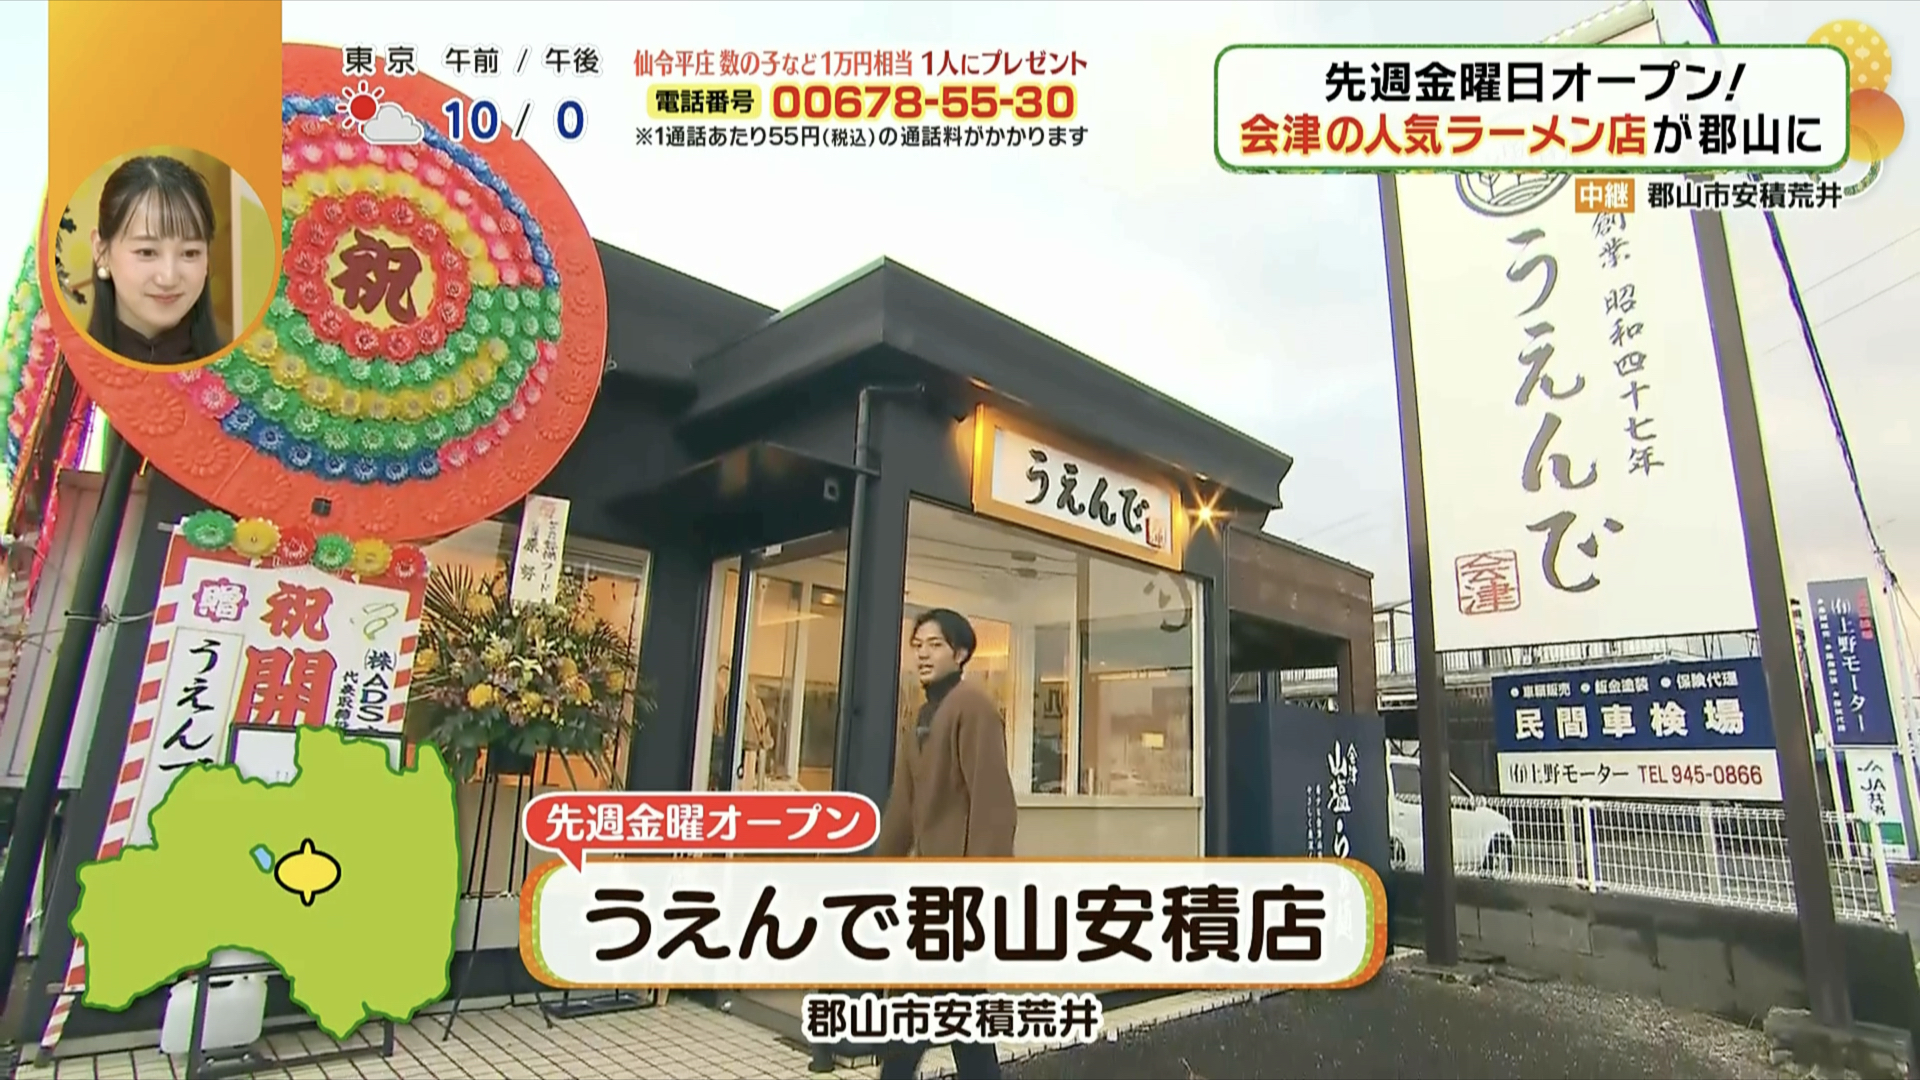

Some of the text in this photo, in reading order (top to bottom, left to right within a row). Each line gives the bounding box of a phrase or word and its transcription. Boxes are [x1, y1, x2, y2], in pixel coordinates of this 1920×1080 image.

[331, 228, 423, 325] 祝
[1506, 228, 1624, 592] うえんで
[1604, 283, 1665, 477] 昭和四十七年
[1025, 448, 1150, 534] うえんで
[1457, 552, 1519, 613] 会津
[1675, 670, 1739, 691] 保険代理
[1515, 698, 1745, 741] 民間車検場
[1638, 764, 1669, 785] TEL
[1671, 763, 1763, 786] 945-0866
